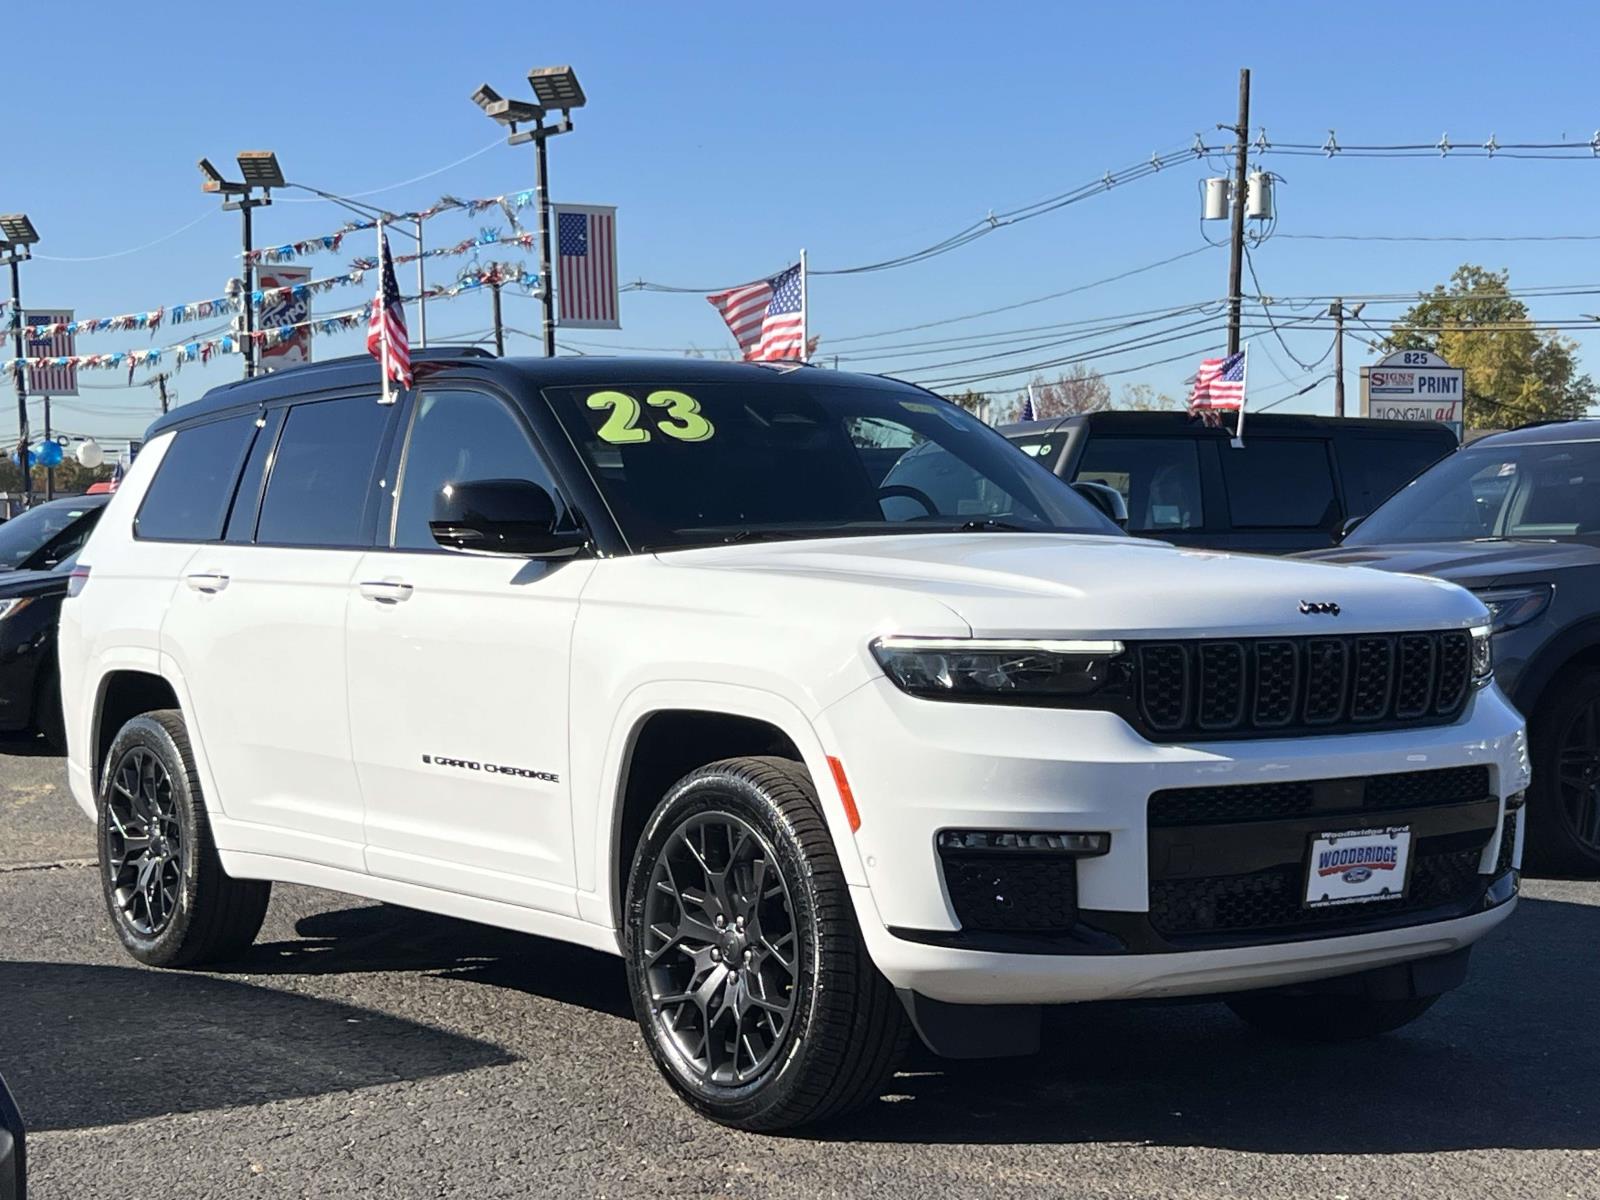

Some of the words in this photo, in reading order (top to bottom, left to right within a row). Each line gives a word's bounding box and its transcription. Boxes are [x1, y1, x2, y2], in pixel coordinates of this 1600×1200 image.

[1404, 353, 1428, 364] 825
[1418, 377, 1459, 393] PRINT
[587, 390, 715, 444] 23
[1435, 400, 1456, 421] ad
[1299, 600, 1340, 616] Jeep
[434, 756, 480, 770] GRAND
[484, 763, 560, 783] CHEROKEE
[1321, 829, 1384, 839] Woodbridge
[1386, 825, 1409, 833] Ford
[1319, 846, 1398, 869] WOODBRIDGE
